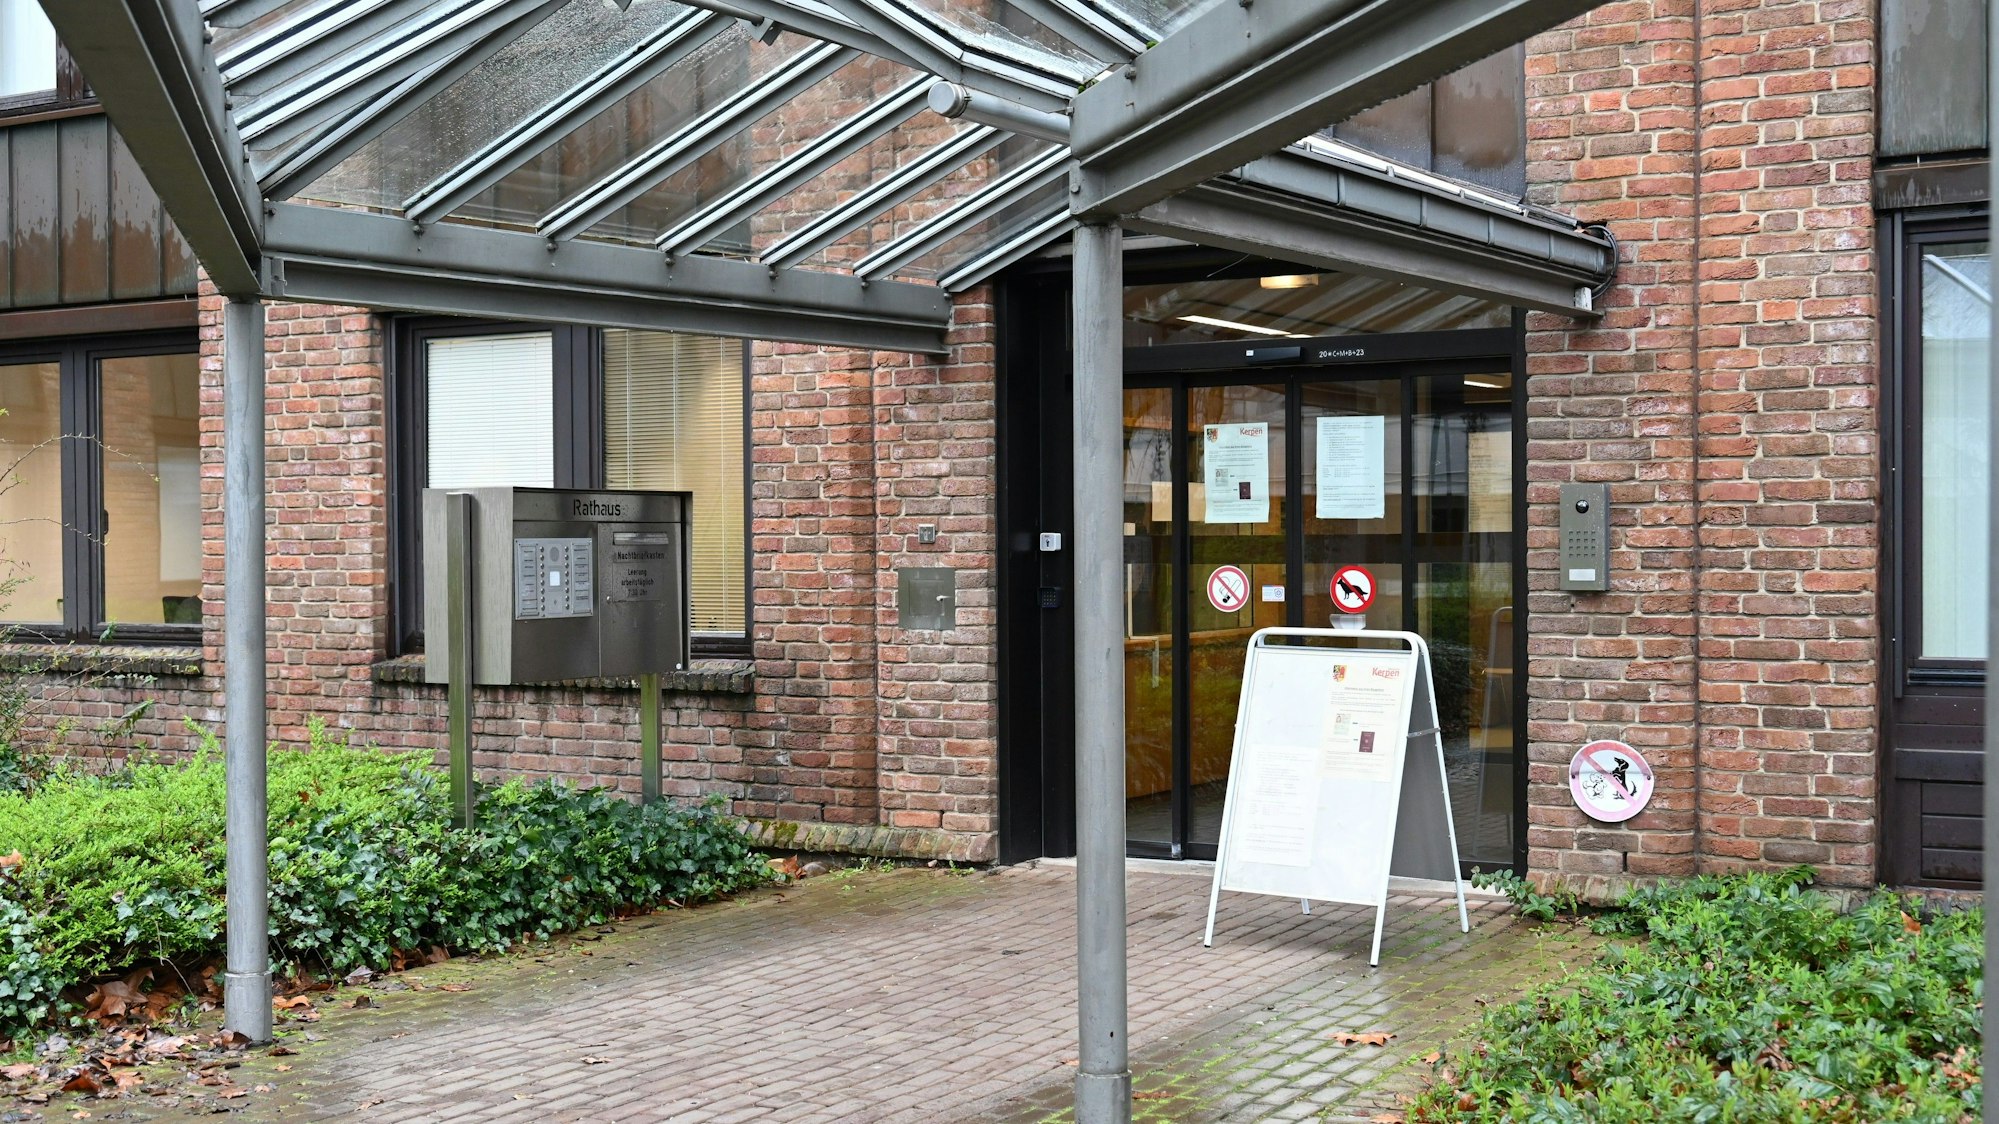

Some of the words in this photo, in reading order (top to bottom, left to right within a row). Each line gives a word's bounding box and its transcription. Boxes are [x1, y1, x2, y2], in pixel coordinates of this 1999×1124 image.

[1240, 428, 1263, 436] Kerpen
[573, 499, 621, 516] Rathaus
[617, 551, 665, 560] Nachtbriefkasten
[628, 568, 647, 577] Leerung
[1372, 667, 1400, 678] Kerpen
